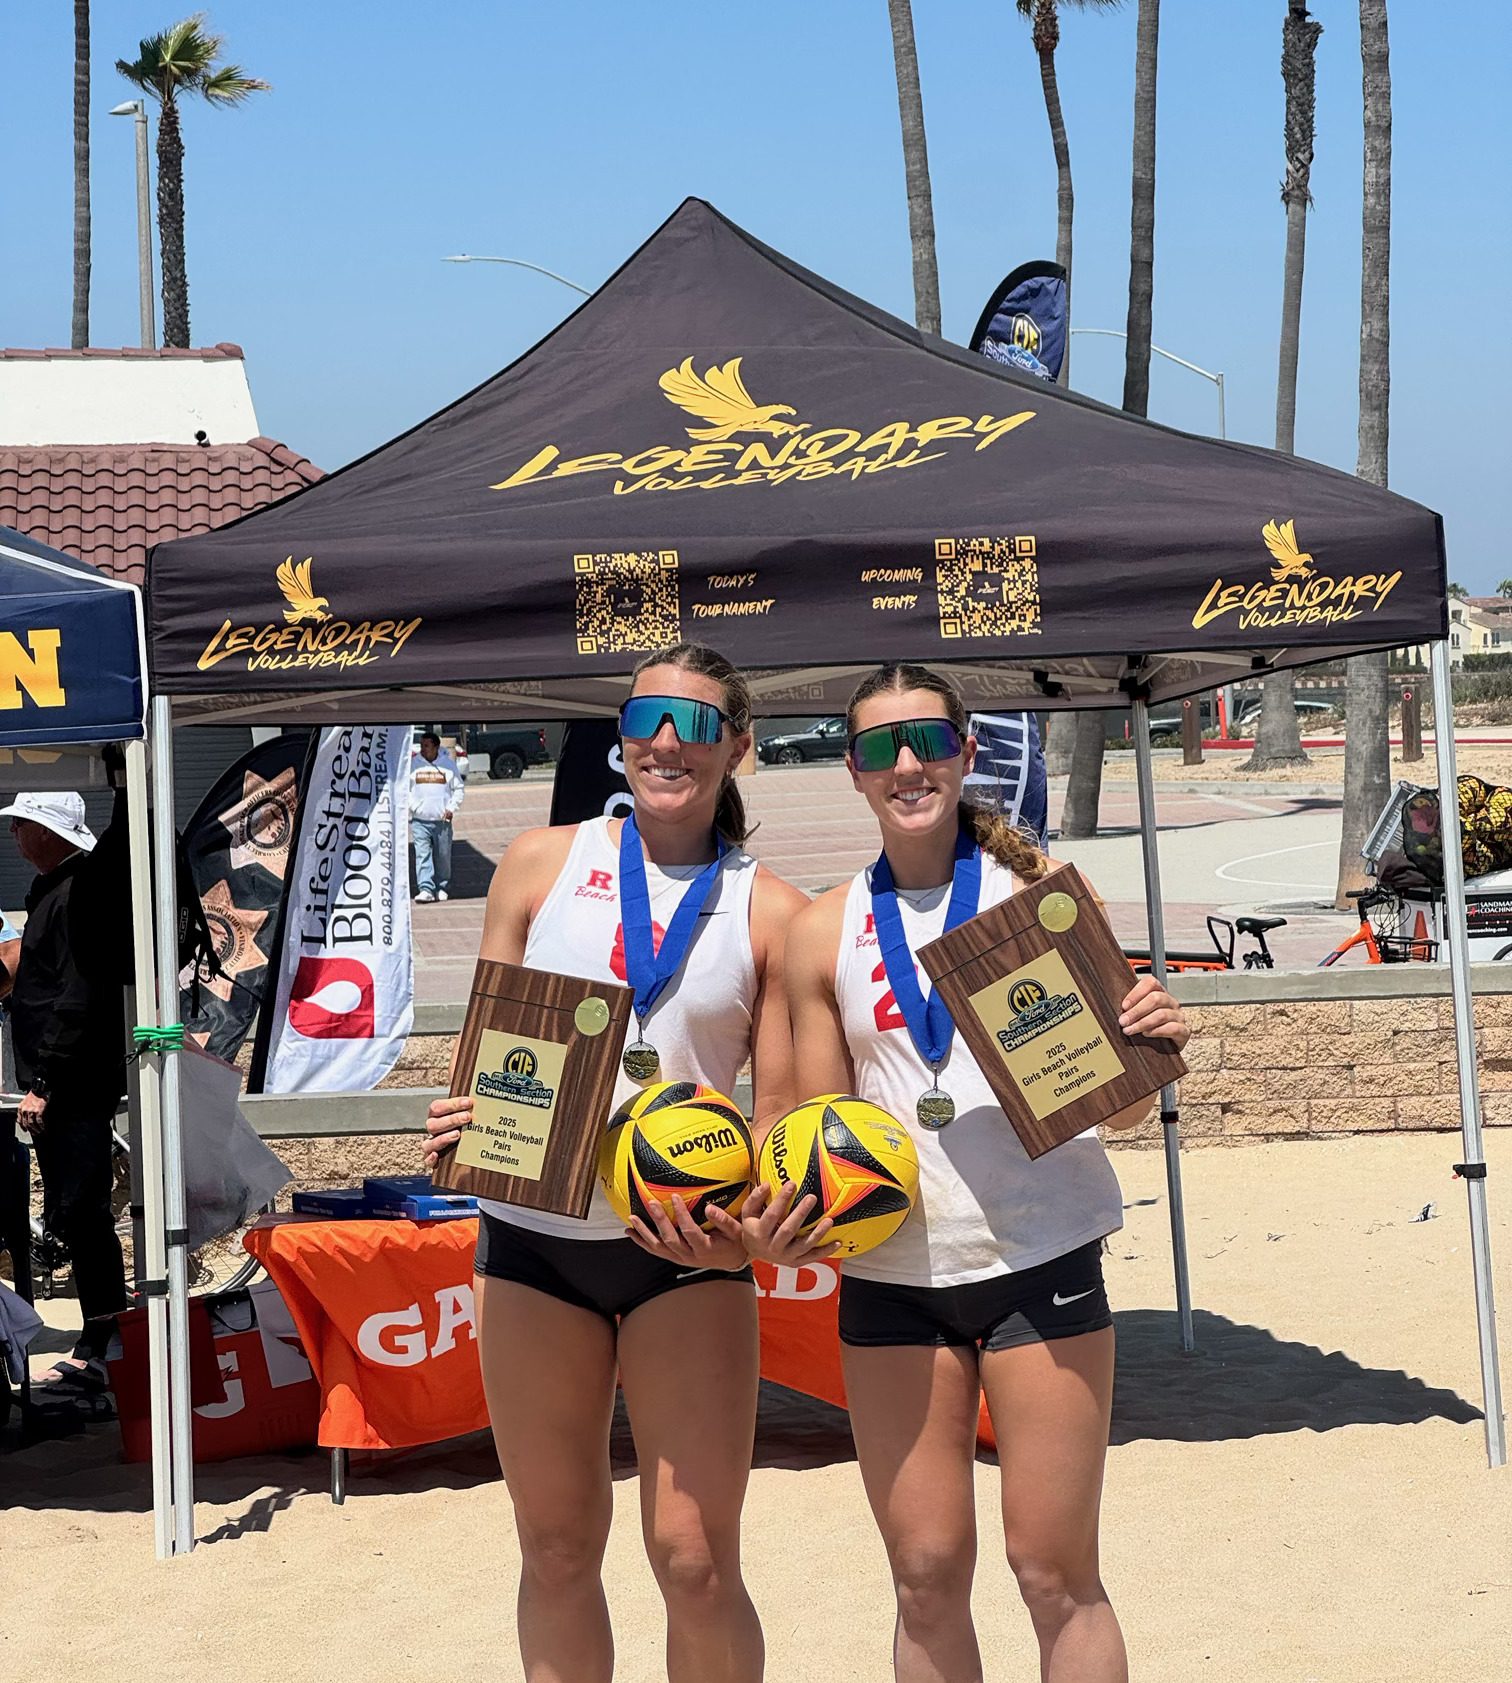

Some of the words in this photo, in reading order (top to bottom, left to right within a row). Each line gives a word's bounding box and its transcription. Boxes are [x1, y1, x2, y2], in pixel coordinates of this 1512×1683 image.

[1012, 347, 1033, 370] Ford
[490, 411, 1037, 490] LEGENDARY
[612, 450, 950, 494] VOLLEYBALL
[707, 572, 757, 590] TODAY'S
[861, 567, 924, 584] UPCOMING
[691, 599, 776, 619] TOURNAMENT
[872, 594, 918, 611] EVENTS
[1191, 570, 1403, 630] LEGENDARY
[1239, 604, 1363, 629] VOLLEYBALL
[196, 617, 423, 671] LEGENDARY
[248, 651, 380, 672] VOLLEYBALL
[374, 728, 392, 817] LSTREAM.
[301, 726, 353, 949] LifeStrea
[332, 815, 374, 948] Blood
[380, 828, 393, 946] 800.879.4484
[586, 869, 613, 891] R
[574, 886, 618, 902] Beach
[855, 935, 878, 949] Bea
[1013, 984, 1041, 1011] CIF
[999, 1020, 1042, 1042] Southern
[1044, 994, 1077, 1020] Section
[1025, 1004, 1047, 1020] Ford
[1003, 1002, 1082, 1051] CHAMPIONSHIPS
[1022, 1072, 1042, 1087] Girls
[1041, 1058, 1066, 1076] Beach
[1065, 1035, 1103, 1062] Volleyball
[1045, 1042, 1067, 1059] 2025
[508, 1052, 533, 1076] CIF
[1058, 1065, 1079, 1081] Pairs
[479, 1074, 517, 1094] Southern
[520, 1088, 552, 1098] Section
[507, 1073, 529, 1086] Ford
[1053, 1070, 1097, 1098] Champions
[477, 1084, 551, 1108] CHAMPIONSHIPS
[498, 1116, 517, 1128] 2025
[467, 1123, 484, 1133] Girls
[485, 1126, 508, 1138] Beach
[509, 1131, 544, 1146] Volleyball
[493, 1140, 512, 1152] Pairs
[666, 1127, 738, 1158] Wilson
[480, 1150, 520, 1166] Champions
[358, 1283, 478, 1367] GA
